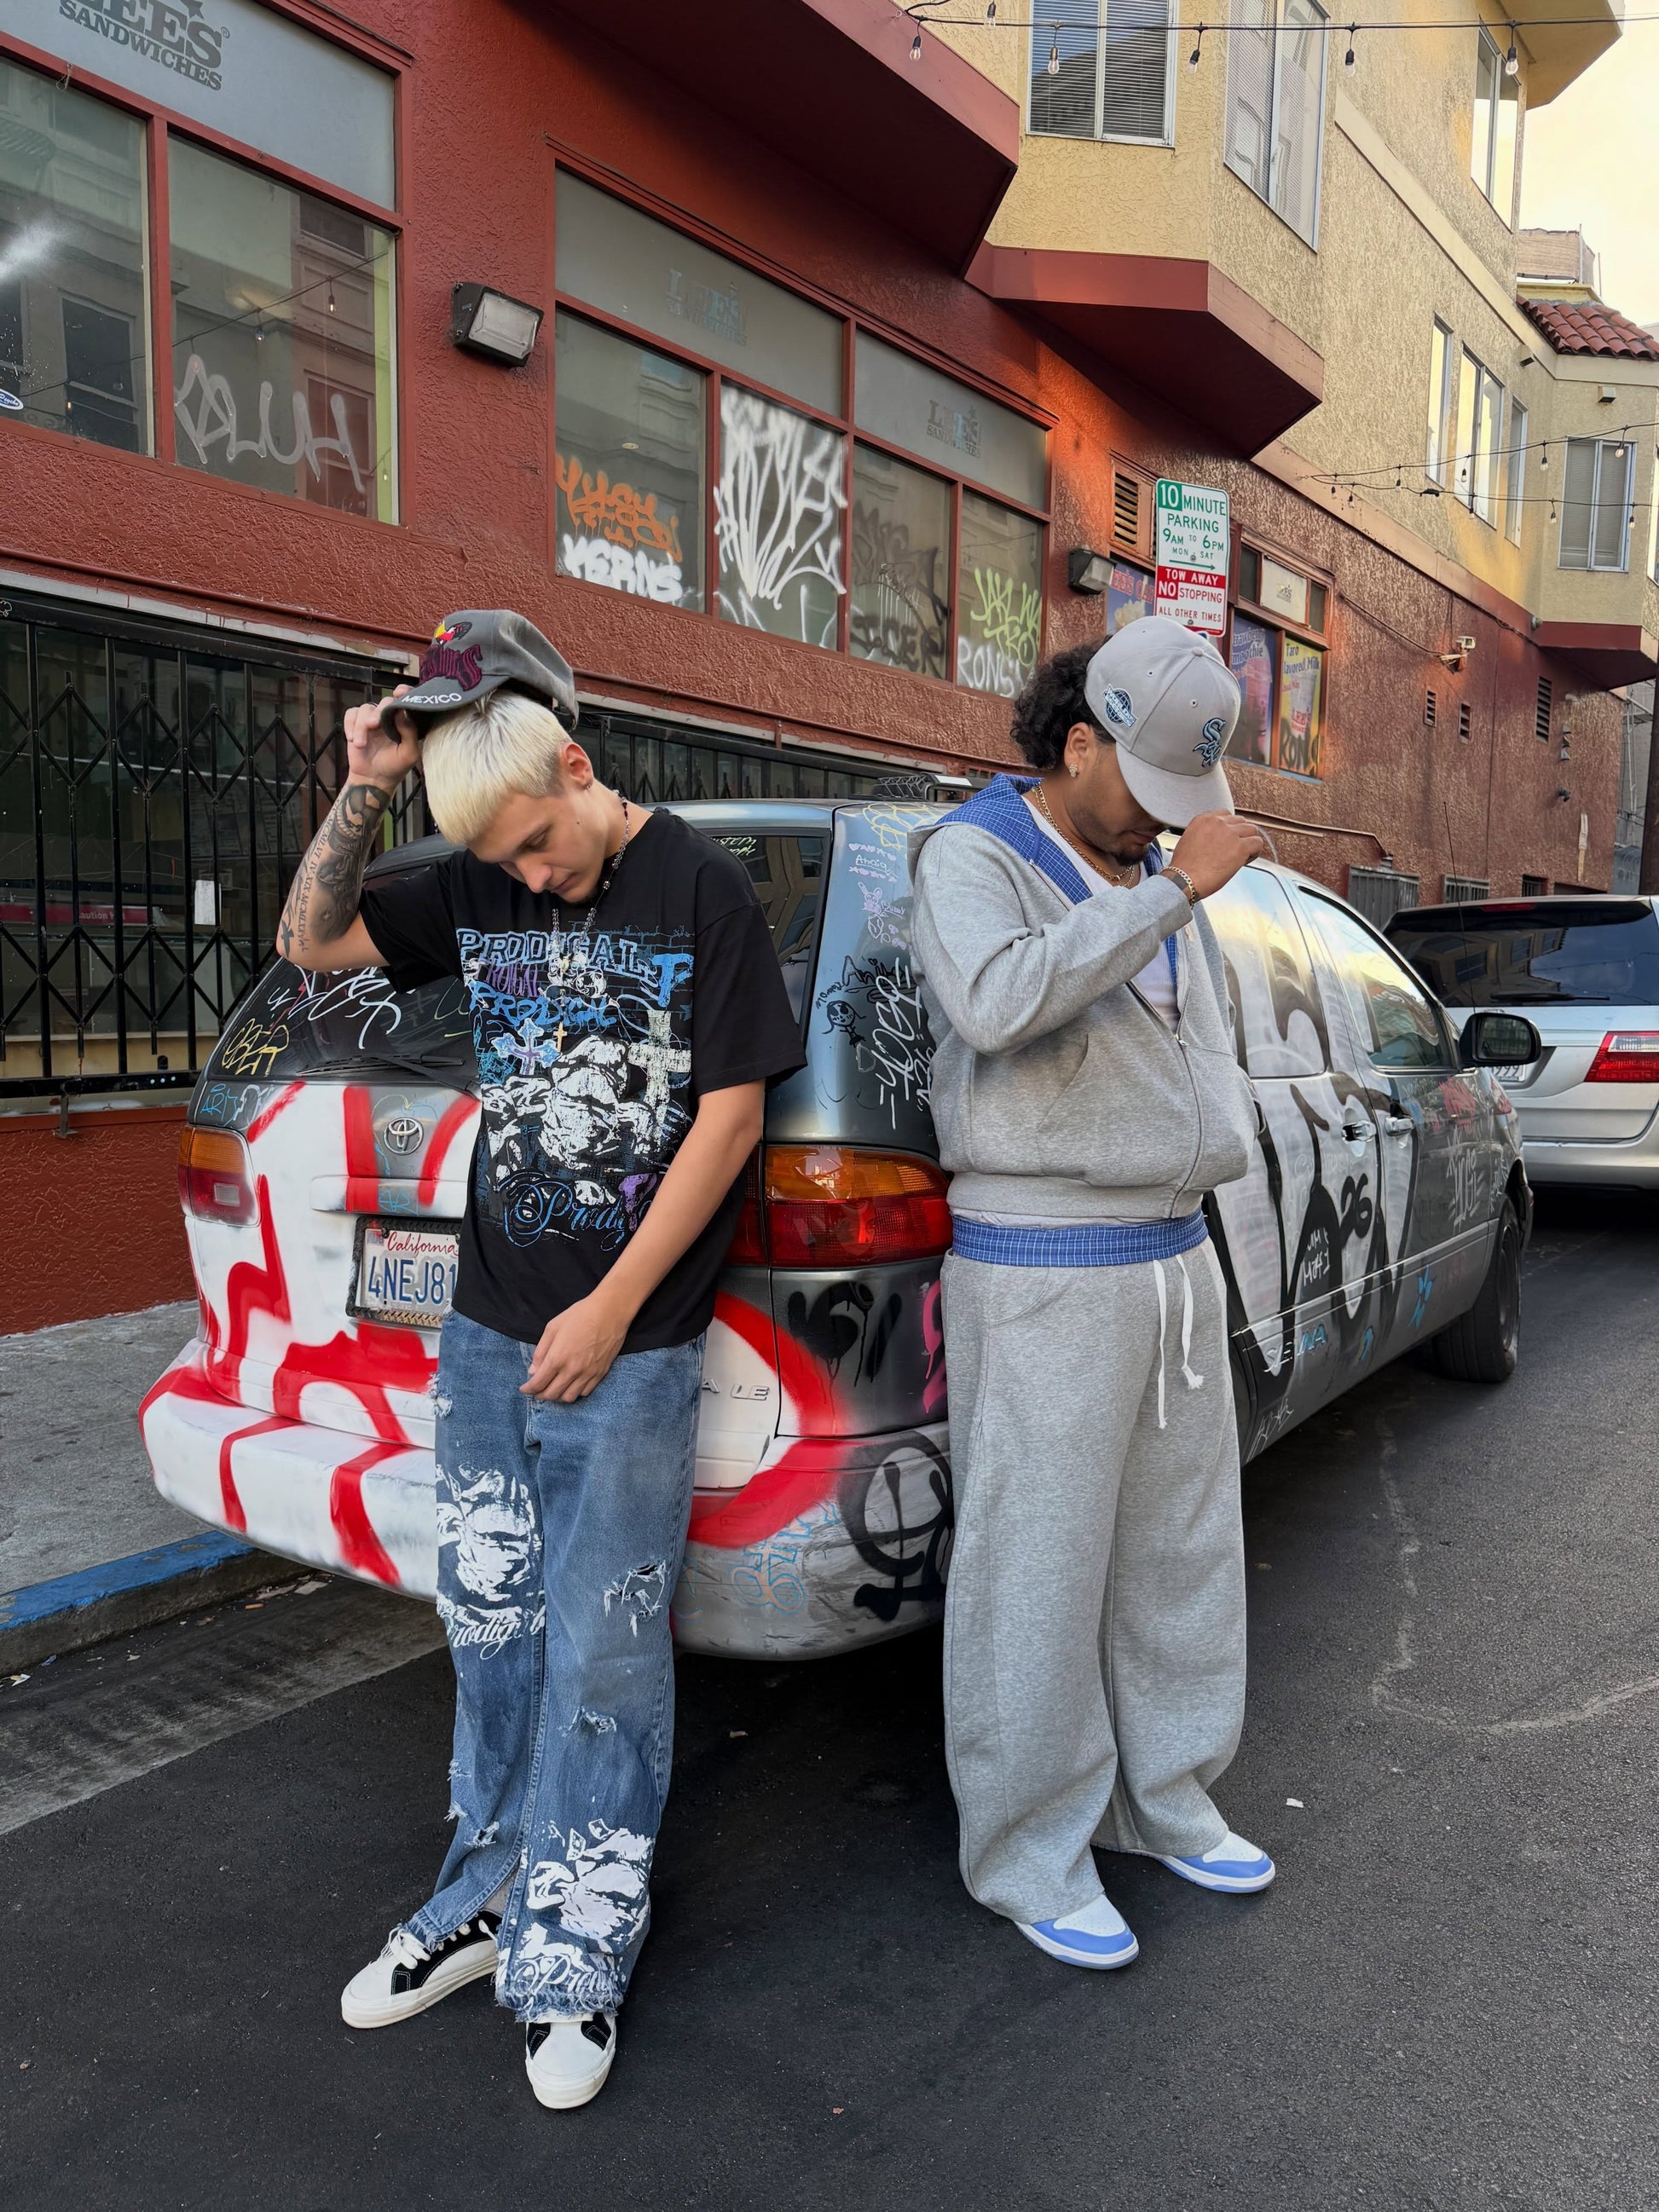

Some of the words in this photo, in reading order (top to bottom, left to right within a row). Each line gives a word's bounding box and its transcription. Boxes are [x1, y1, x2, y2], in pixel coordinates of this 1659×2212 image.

[59, 2, 222, 91] SANDWICHES
[1160, 483, 1179, 508] 10
[1183, 494, 1226, 516] MINUTE
[1167, 512, 1219, 533] PARKING
[1172, 546, 1188, 556] MON
[1199, 551, 1214, 560] SAT
[1165, 568, 1186, 581] TOW
[1190, 572, 1218, 586] AWAY
[1159, 580, 1176, 597] NO
[1179, 587, 1223, 604] STOPPING
[1159, 606, 1172, 616] ALL
[1175, 608, 1198, 619] OTHER
[1201, 611, 1222, 622] TIMES
[1232, 642, 1263, 665] moothie
[1286, 644, 1298, 657] Taro
[1283, 660, 1305, 675] lavored
[1307, 656, 1320, 671] Milk
[402, 692, 462, 704] MEXICO
[79, 910, 108, 920] aution
[387, 1231, 459, 1256] California
[731, 1383, 769, 1401] LE
